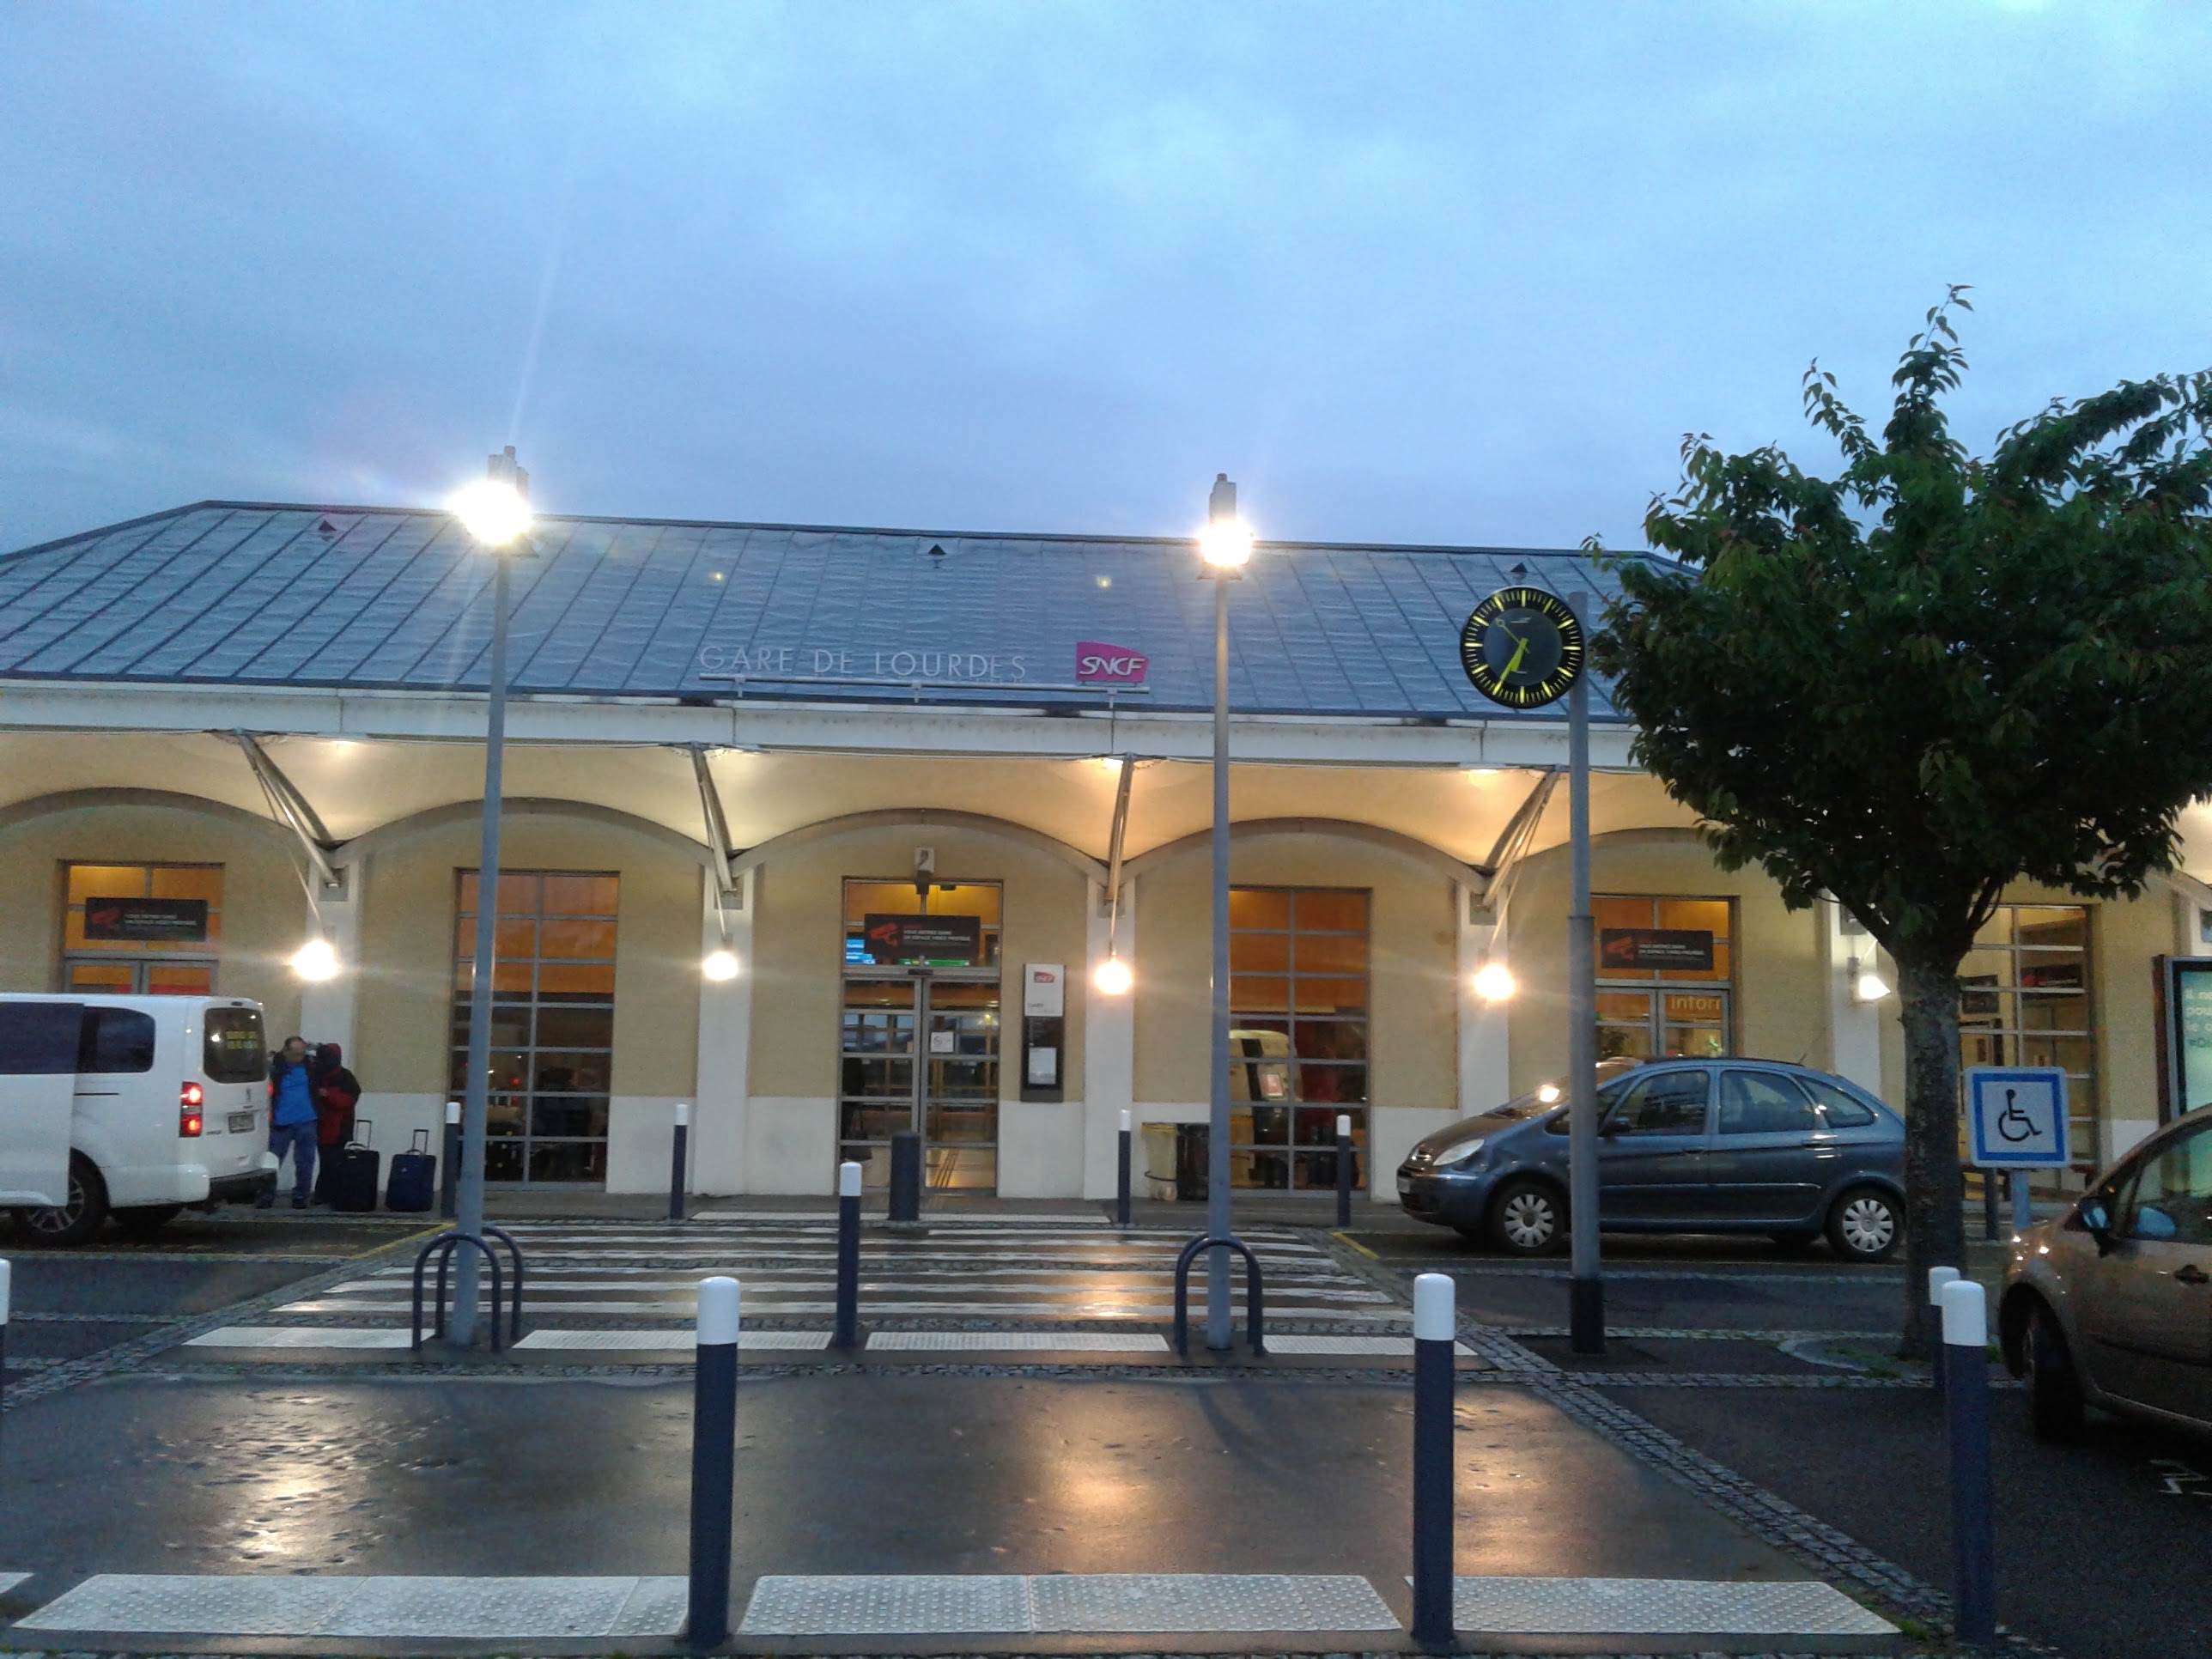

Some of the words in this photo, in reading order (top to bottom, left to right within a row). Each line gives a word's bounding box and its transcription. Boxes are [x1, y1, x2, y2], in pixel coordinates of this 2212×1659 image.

[700, 646, 794, 672] GARE
[814, 648, 854, 674] DE
[875, 651, 1026, 679] LOURDES
[1079, 656, 1146, 676] SNCF
